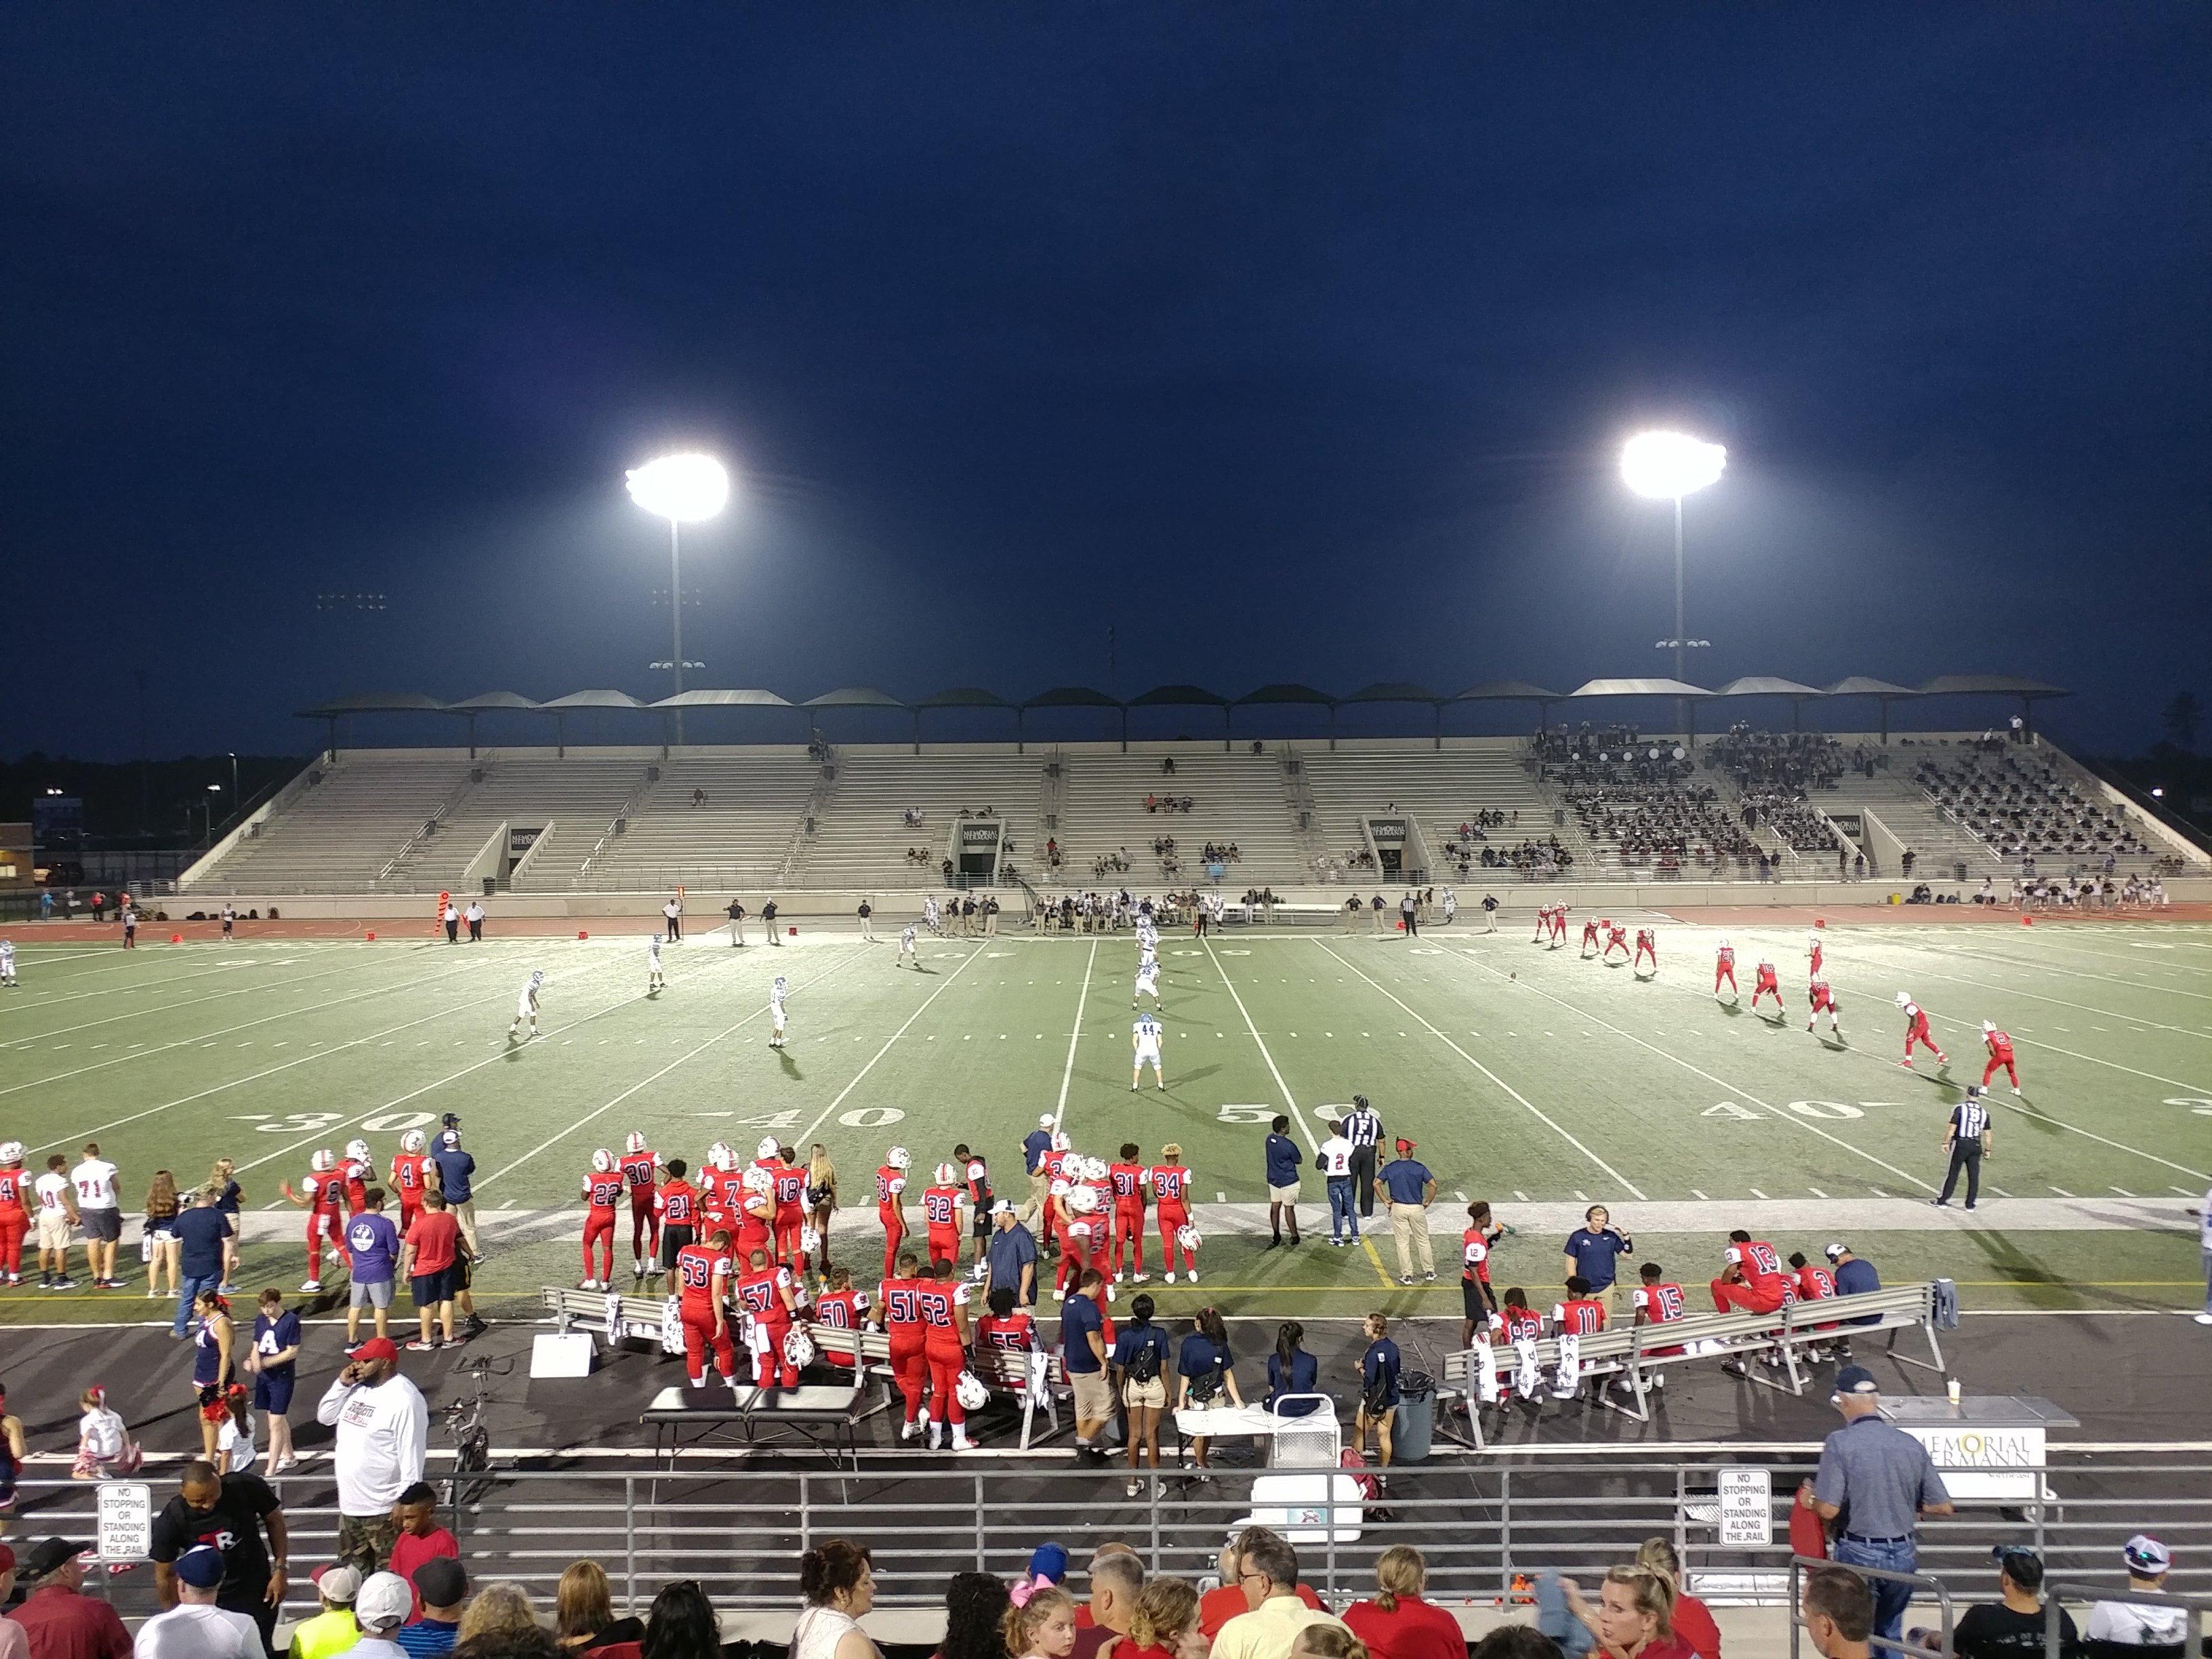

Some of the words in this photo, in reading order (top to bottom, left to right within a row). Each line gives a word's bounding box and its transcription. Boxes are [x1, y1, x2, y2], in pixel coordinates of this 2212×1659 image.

[1142, 1024, 1155, 1036] 44
[1969, 1107, 1981, 1123] B
[1357, 1119, 1370, 1134] F
[1335, 1153, 1345, 1170] 2
[401, 1163, 414, 1187] 4
[624, 1160, 653, 1186] 30
[79, 1180, 102, 1198] 71
[594, 1182, 619, 1206] 22
[724, 1181, 741, 1208] 7
[778, 1178, 800, 1203] 18
[1113, 1172, 1134, 1197] 31
[1155, 1172, 1180, 1198] 34
[668, 1195, 691, 1219] 21
[926, 1195, 951, 1223] 32
[1470, 1248, 1479, 1257] 12
[1748, 1245, 1779, 1275] 13
[681, 1254, 709, 1288] 53
[741, 1280, 773, 1313] 57
[889, 1289, 918, 1323] 51
[1657, 1287, 1683, 1321] 15
[820, 1300, 848, 1328] 50
[921, 1292, 951, 1327] 52
[1577, 1307, 1597, 1335] 11
[258, 1330, 280, 1354] A
[987, 1331, 1024, 1352] 55
[1509, 1319, 1538, 1345] 82
[1930, 1451, 2030, 1467] ERMANN
[1737, 1474, 1750, 1483] NO
[118, 1488, 131, 1497] NO
[1723, 1486, 1766, 1495] STOPPING
[103, 1499, 146, 1508] STOPPING
[1738, 1497, 1752, 1506] OR
[118, 1511, 131, 1519] OR
[1723, 1509, 1767, 1518] STANDING
[103, 1523, 146, 1531] STANDING
[1730, 1521, 1761, 1530] ALONG
[110, 1534, 140, 1542] ALONG
[1725, 1532, 1742, 1541] THE
[1746, 1532, 1765, 1541] RAIL
[105, 1545, 121, 1554] THE
[125, 1545, 144, 1554] RAIL
